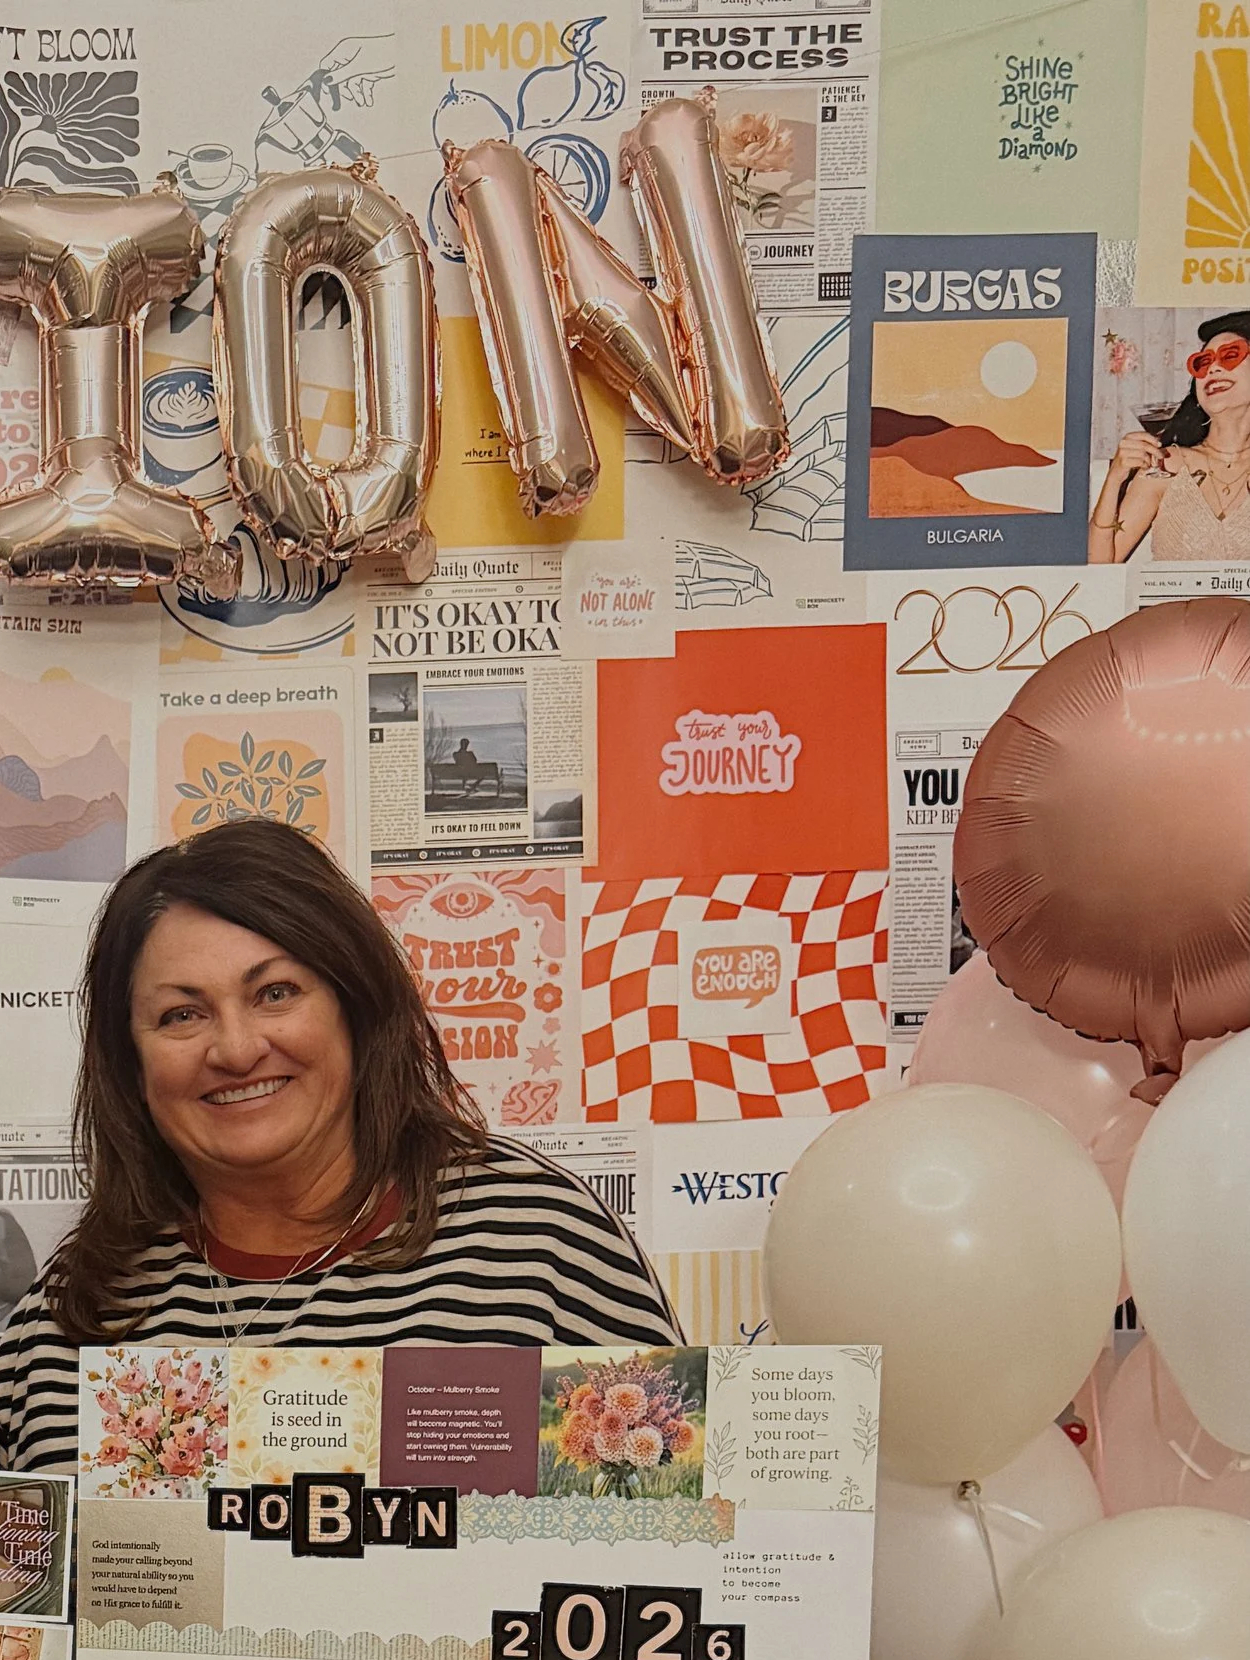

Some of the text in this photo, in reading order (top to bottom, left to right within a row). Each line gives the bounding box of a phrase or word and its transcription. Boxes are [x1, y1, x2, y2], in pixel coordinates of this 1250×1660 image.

[650, 23, 863, 48] TRUST THE
[37, 27, 137, 62] BLOOM
[441, 20, 574, 72] LIMON
[663, 48, 851, 71] PROCESS
[822, 86, 861, 95] PATIENCE
[822, 93, 866, 103] IS THE KEY
[998, 81, 1079, 107] BRIGHT
[1032, 126, 1045, 142] a
[763, 244, 814, 259] JOURNEY
[883, 267, 1061, 313] BURGAS
[927, 528, 1003, 545] BULGARIA
[581, 591, 653, 612] NOT ALONE
[375, 604, 430, 632] IT'S
[437, 600, 523, 627] OKAY
[47, 618, 82, 634] SUN
[895, 583, 1093, 675] 2026
[372, 627, 561, 658] NOT BE OKA
[426, 666, 524, 679] EMBRACE YOUR EMOTIONS
[161, 685, 338, 710] Take a deep breath
[685, 718, 771, 741] trust your
[669, 744, 793, 786] JOURNEY
[904, 770, 959, 805] YOU
[403, 927, 521, 970] TRUST
[697, 954, 736, 972] YOU
[752, 1367, 833, 1384] Some days
[263, 1390, 348, 1407] Gratitude
[752, 1390, 780, 1403] you
[271, 1411, 342, 1428] is seed in
[752, 1409, 829, 1424] some days
[262, 1433, 347, 1450] the ground
[754, 1430, 780, 1443] you
[746, 1447, 840, 1463] both are part
[751, 1467, 832, 1482] of growing.
[221, 1485, 447, 1543] ROBYN
[723, 1552, 755, 1561] allow
[762, 1552, 821, 1562] gratitude
[723, 1566, 781, 1574] intention
[741, 1580, 781, 1588] become
[722, 1594, 800, 1604] your compass
